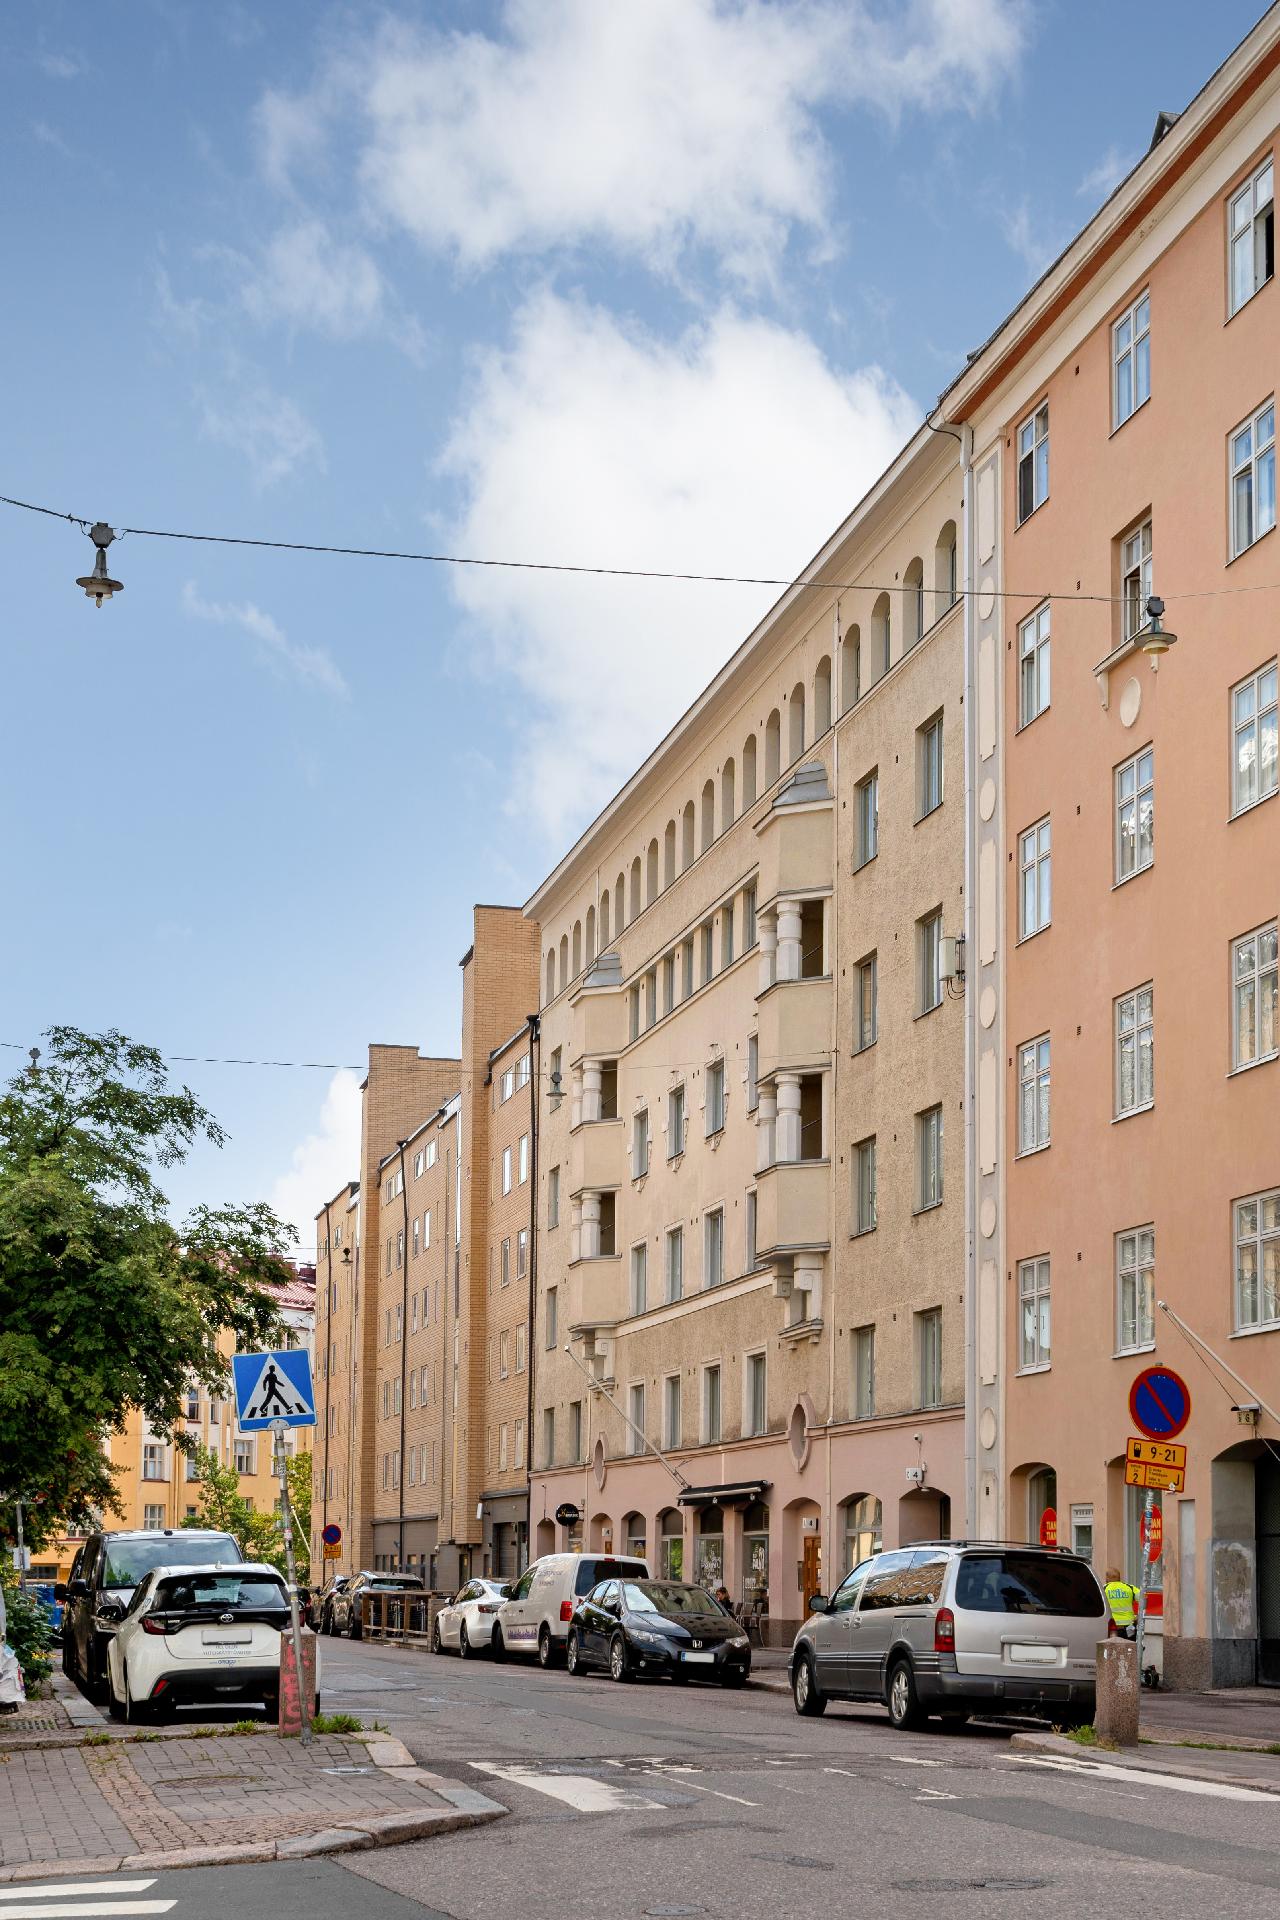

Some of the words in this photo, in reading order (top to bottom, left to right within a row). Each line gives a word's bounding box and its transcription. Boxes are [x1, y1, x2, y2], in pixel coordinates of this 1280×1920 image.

[1150, 1446, 1176, 1463] 9-21
[912, 1471, 919, 1479] 4
[1132, 1472, 1139, 1483] 2
